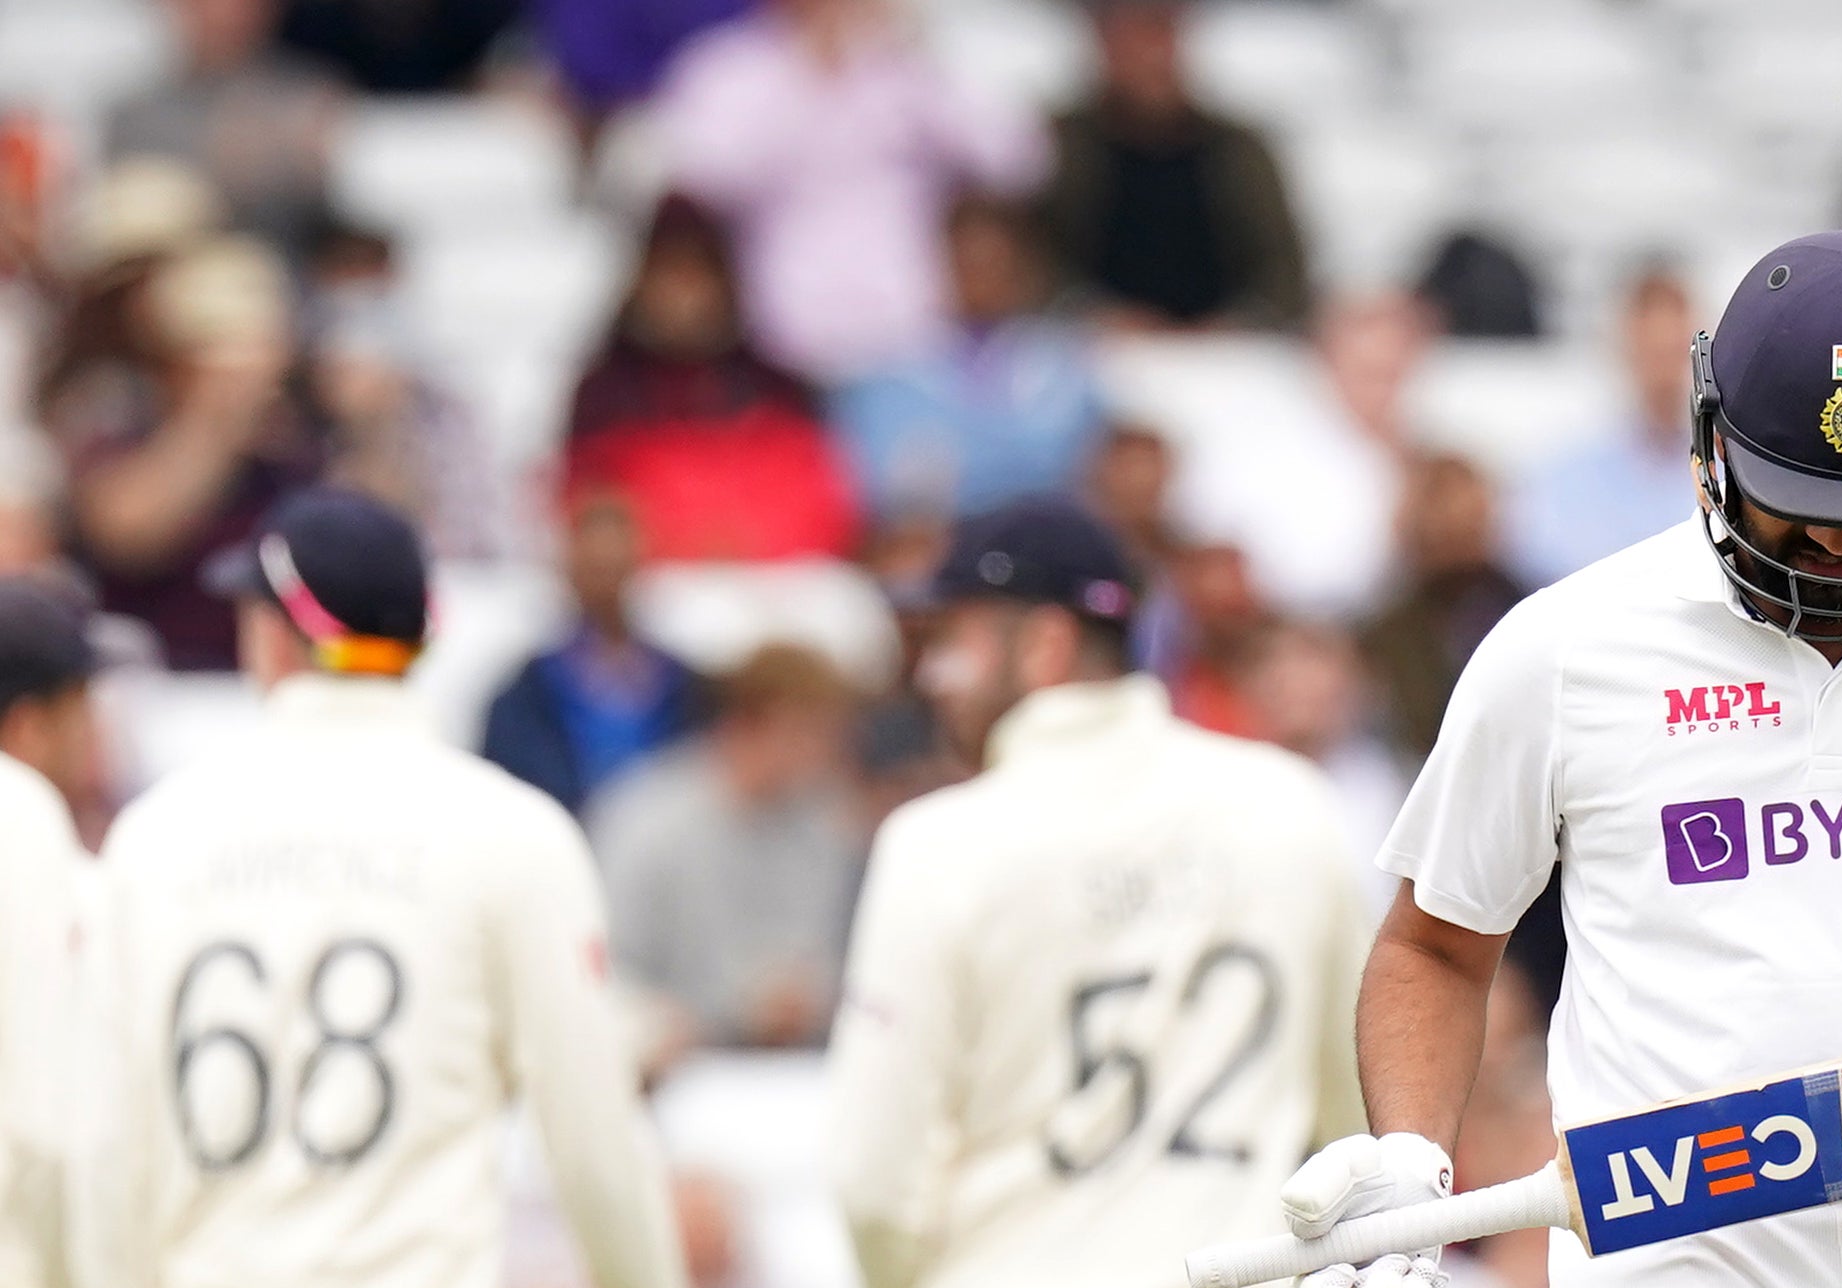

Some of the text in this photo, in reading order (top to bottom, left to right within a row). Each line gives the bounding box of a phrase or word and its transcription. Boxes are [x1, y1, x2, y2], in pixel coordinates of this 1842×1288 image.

[1664, 681, 1781, 724] MPL
[1667, 716, 1782, 736] SPORTS
[1679, 811, 1733, 872] B
[170, 934, 405, 1172] 68
[1045, 938, 1286, 1178] 52
[1600, 1114, 1818, 1222] CEAT
